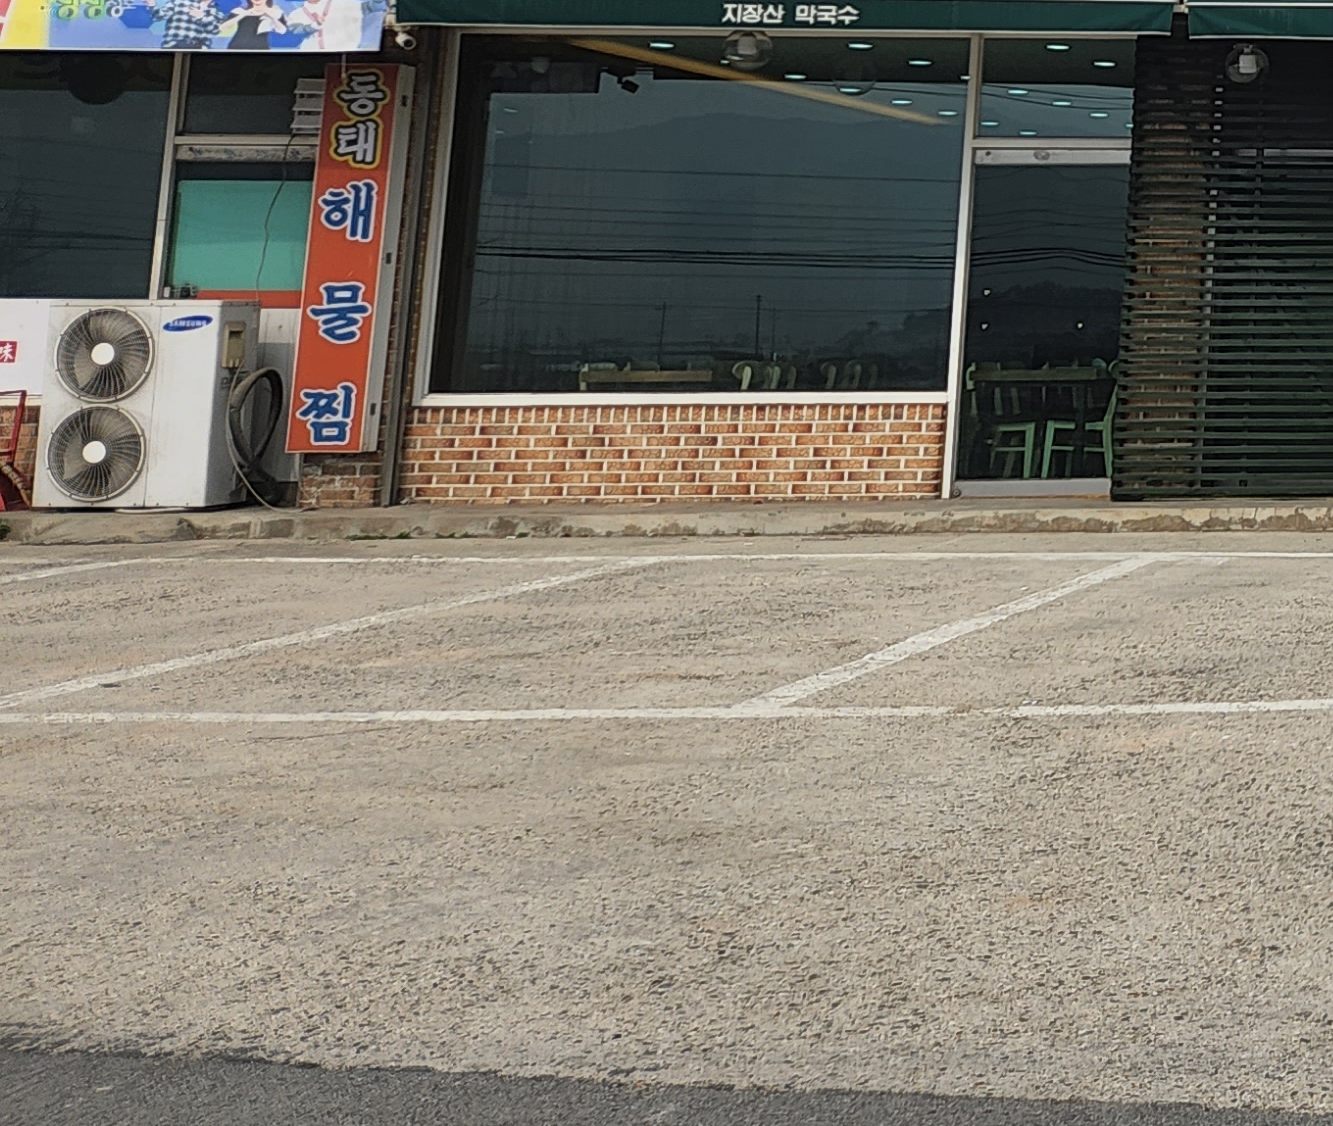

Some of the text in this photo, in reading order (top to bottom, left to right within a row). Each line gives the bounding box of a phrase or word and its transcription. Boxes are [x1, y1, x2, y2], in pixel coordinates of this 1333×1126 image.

[721, 3, 860, 25] 지장산 막국수
[296, 73, 385, 445] 동태 해물찜
